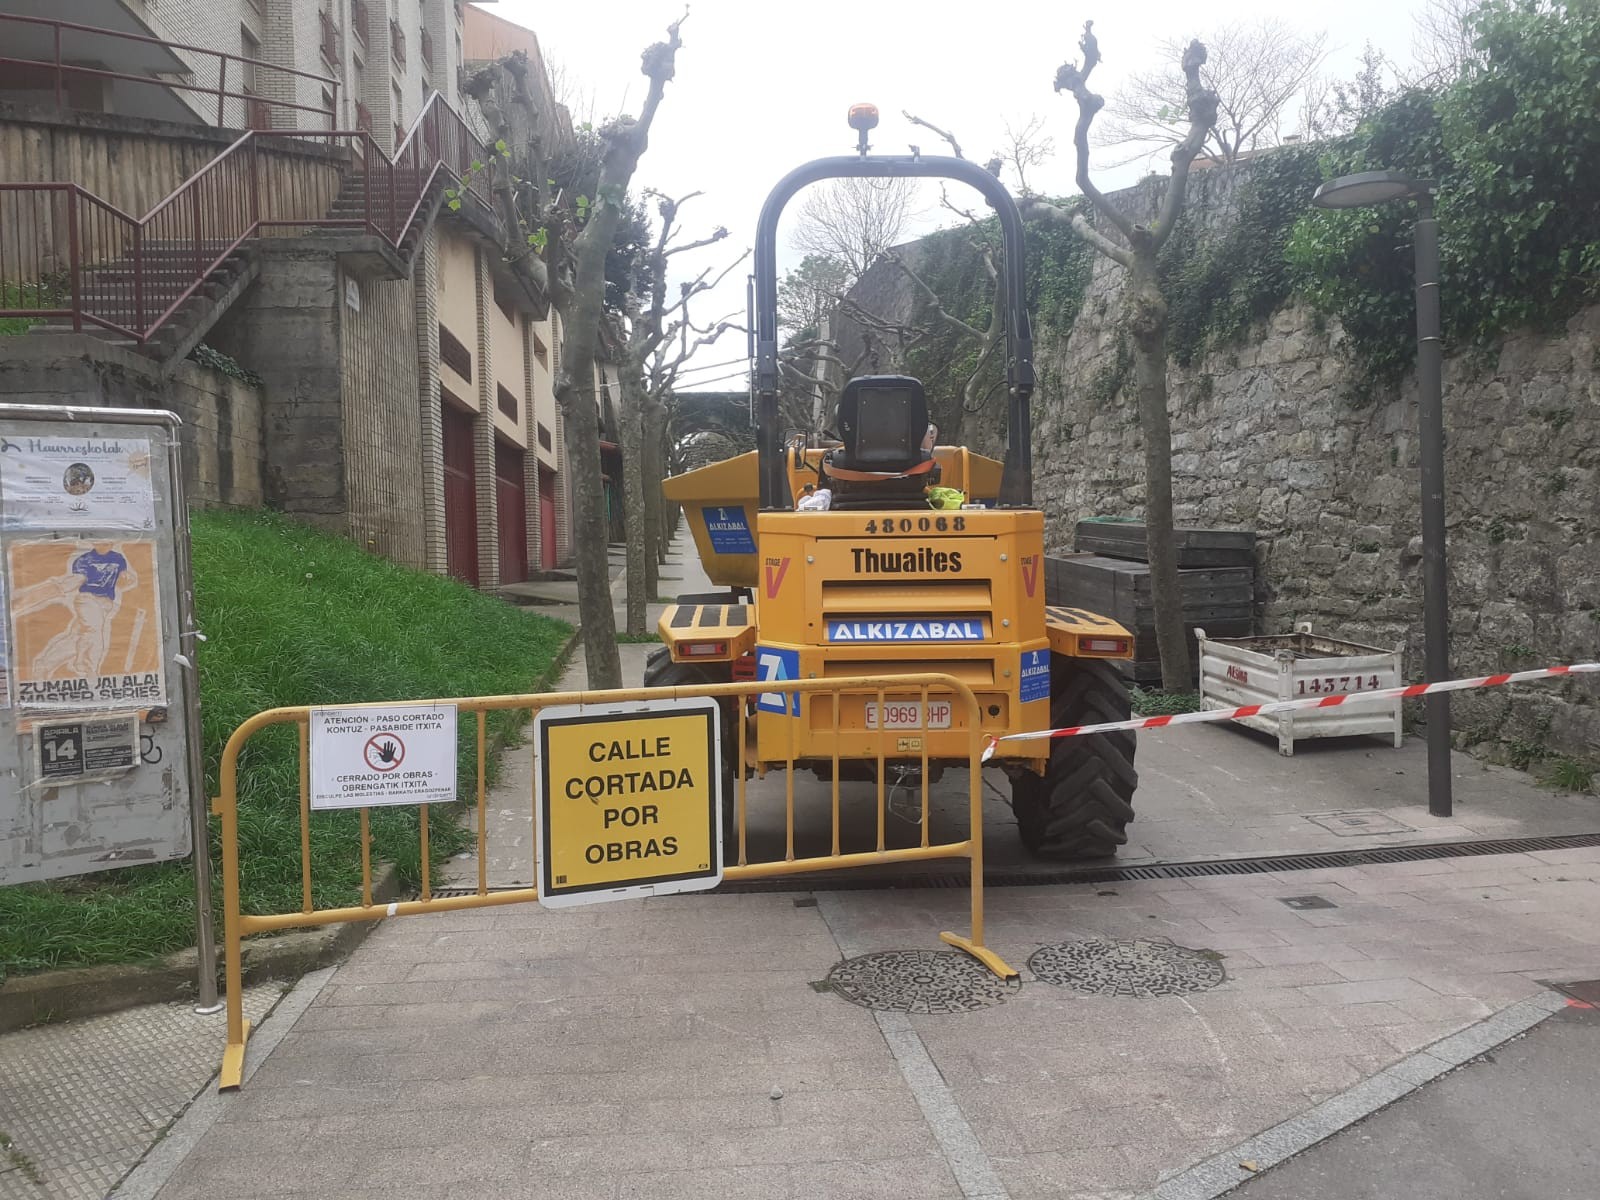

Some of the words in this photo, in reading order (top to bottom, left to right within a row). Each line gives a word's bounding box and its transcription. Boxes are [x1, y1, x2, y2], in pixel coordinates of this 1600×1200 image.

[865, 516, 966, 534] 480068
[766, 557, 781, 567] STAGE
[851, 547, 962, 573] Thwaites
[766, 557, 791, 599] V
[1022, 554, 1039, 598] V
[833, 622, 978, 641] ALKIZABAL
[20, 678, 89, 695] ZUMAIA
[95, 677, 117, 690] JAI
[122, 673, 159, 688] ALAI
[100, 685, 161, 700] SERIES
[376, 714, 400, 723] PASO
[403, 713, 445, 722] CORTADO
[867, 707, 876, 723] E
[327, 725, 363, 734] KONTUZ
[370, 723, 414, 732] PASABIDE
[415, 722, 442, 730] ITXITA
[44, 739, 78, 761] 14
[588, 736, 671, 763] CALLE
[336, 773, 380, 782] CERRADO
[382, 771, 401, 780] POR
[403, 770, 433, 779] OBRAS
[342, 782, 399, 792] OBRENGATIK
[401, 780, 428, 788] ITXITA
[565, 768, 694, 800] CORTADA
[604, 805, 659, 829] POR
[585, 836, 678, 864] OBRAS
